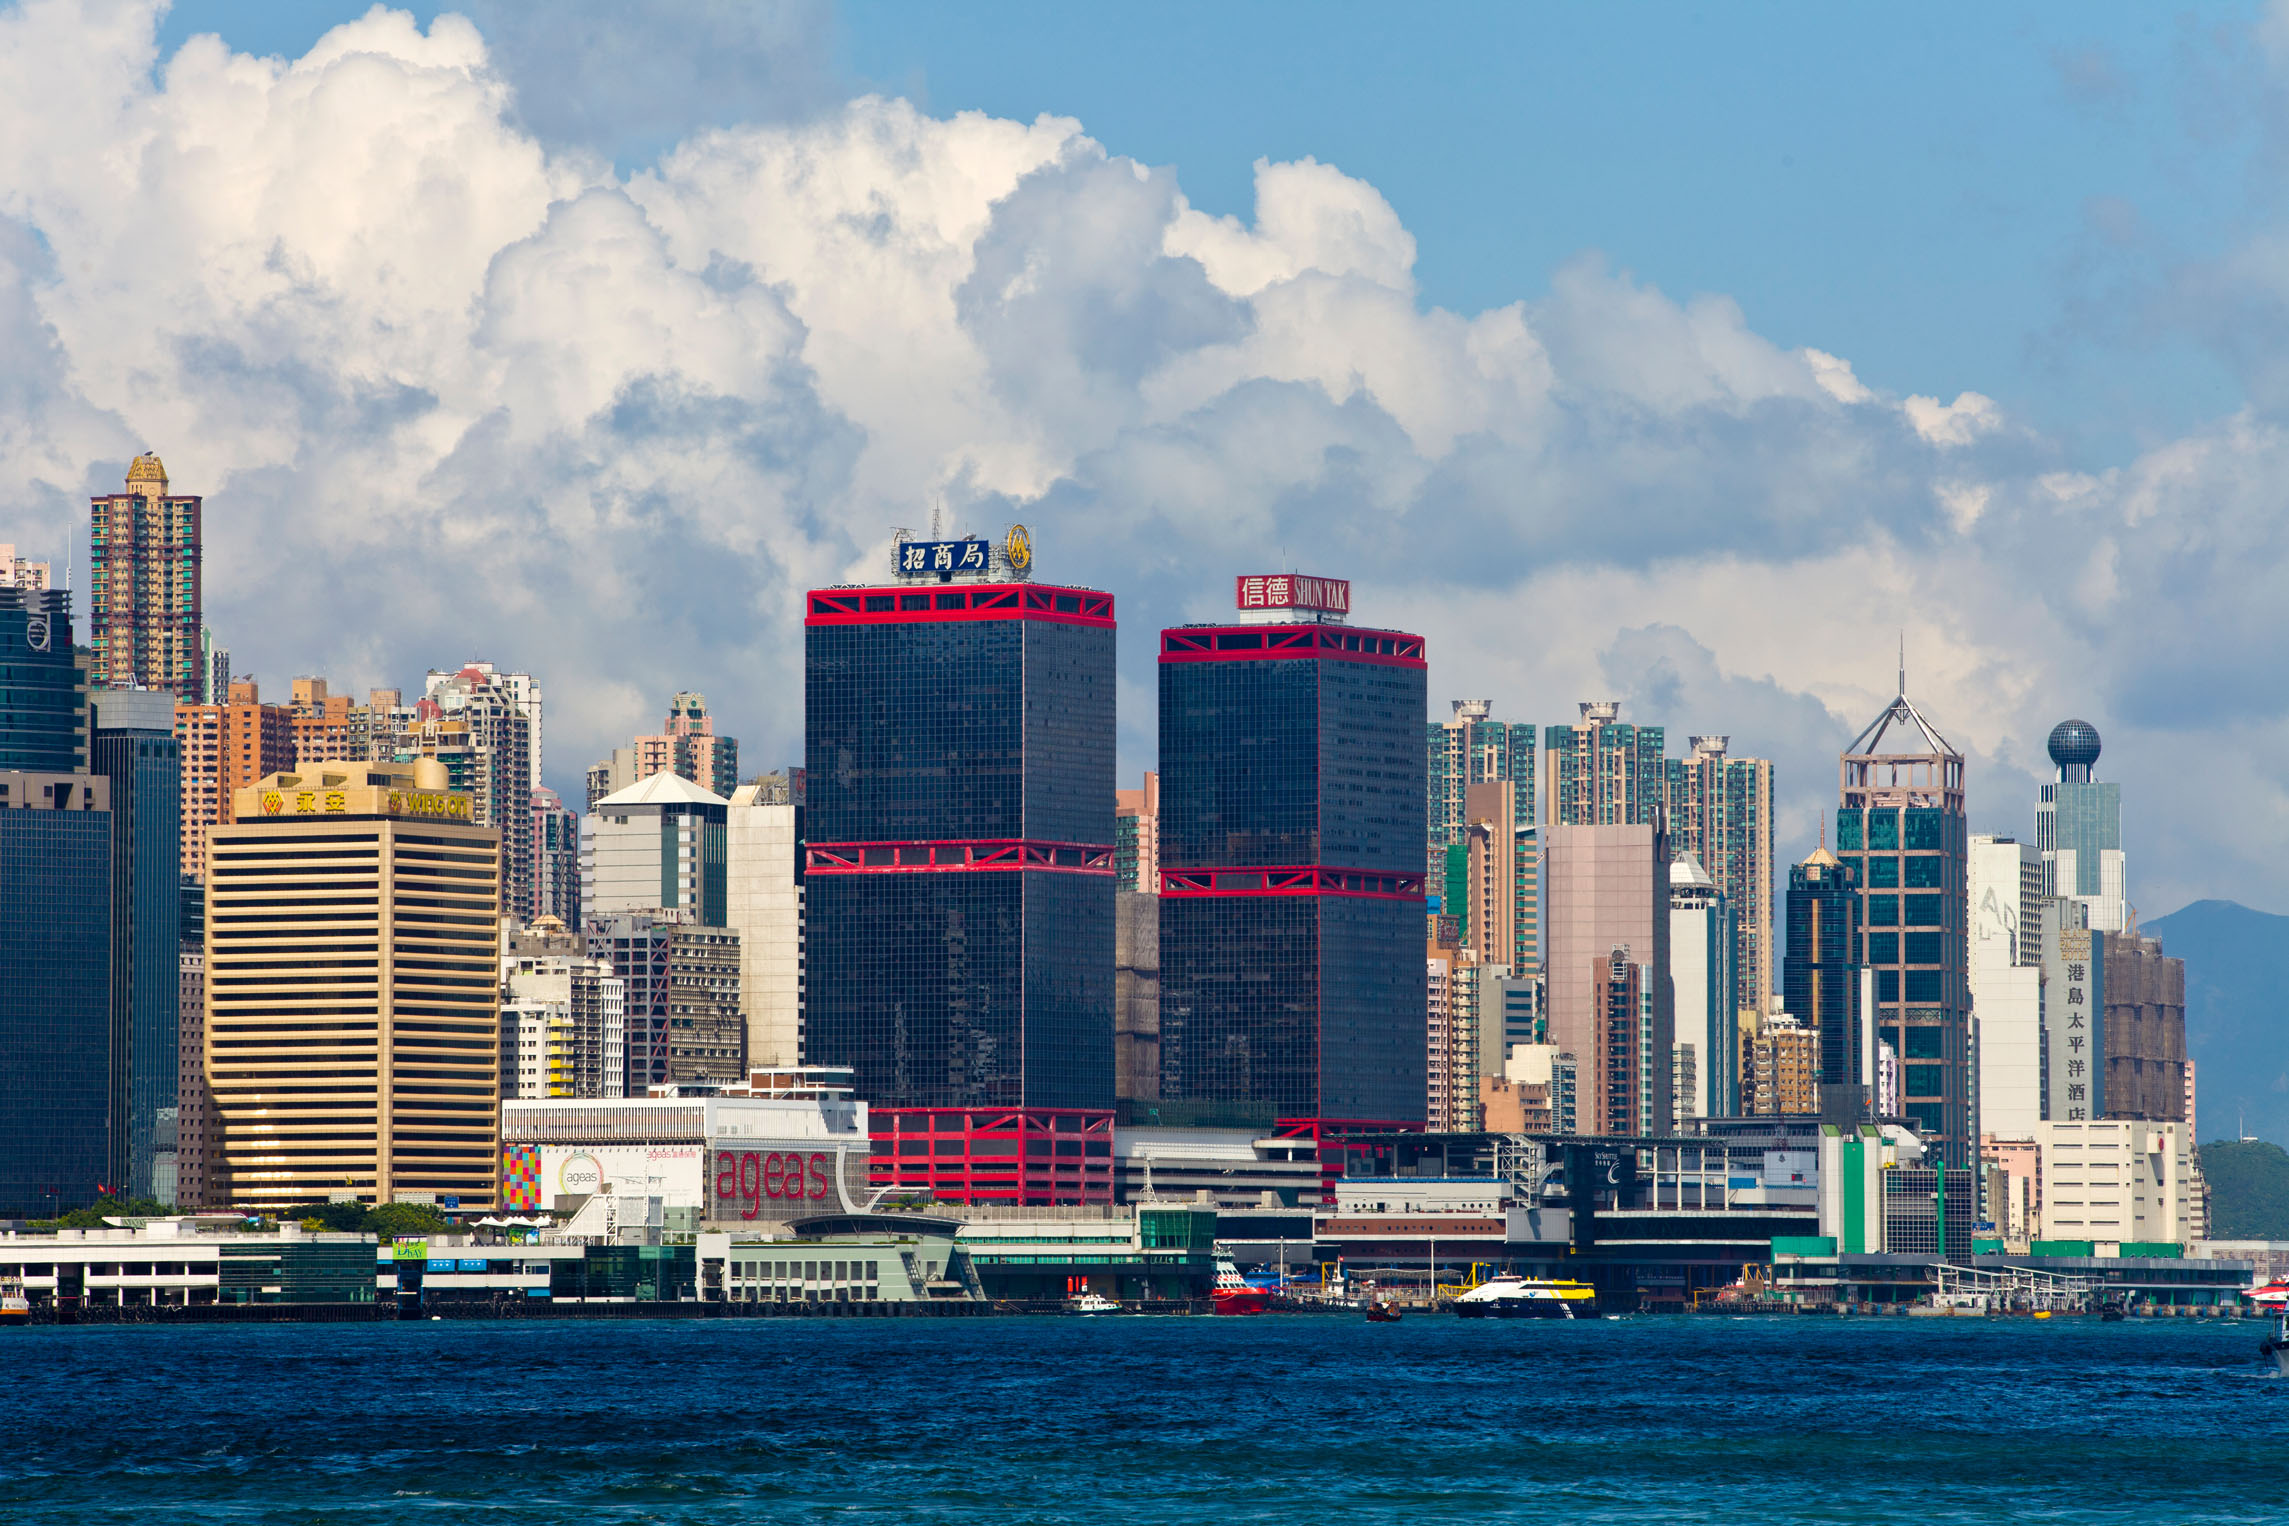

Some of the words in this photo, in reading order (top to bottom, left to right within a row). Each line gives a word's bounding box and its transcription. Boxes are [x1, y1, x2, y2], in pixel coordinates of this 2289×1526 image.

[902, 543, 984, 571] 招商局
[1242, 577, 1289, 606] 信德
[1295, 577, 1323, 608] SHUN
[1325, 580, 1347, 610] TAK
[296, 790, 345, 812] 永安
[2060, 928, 2091, 939] ISLAND
[2060, 940, 2091, 950] PACIFIC
[2061, 951, 2090, 960] HOTEL
[566, 1171, 597, 1185] ageas
[716, 1151, 828, 1220] ageas
